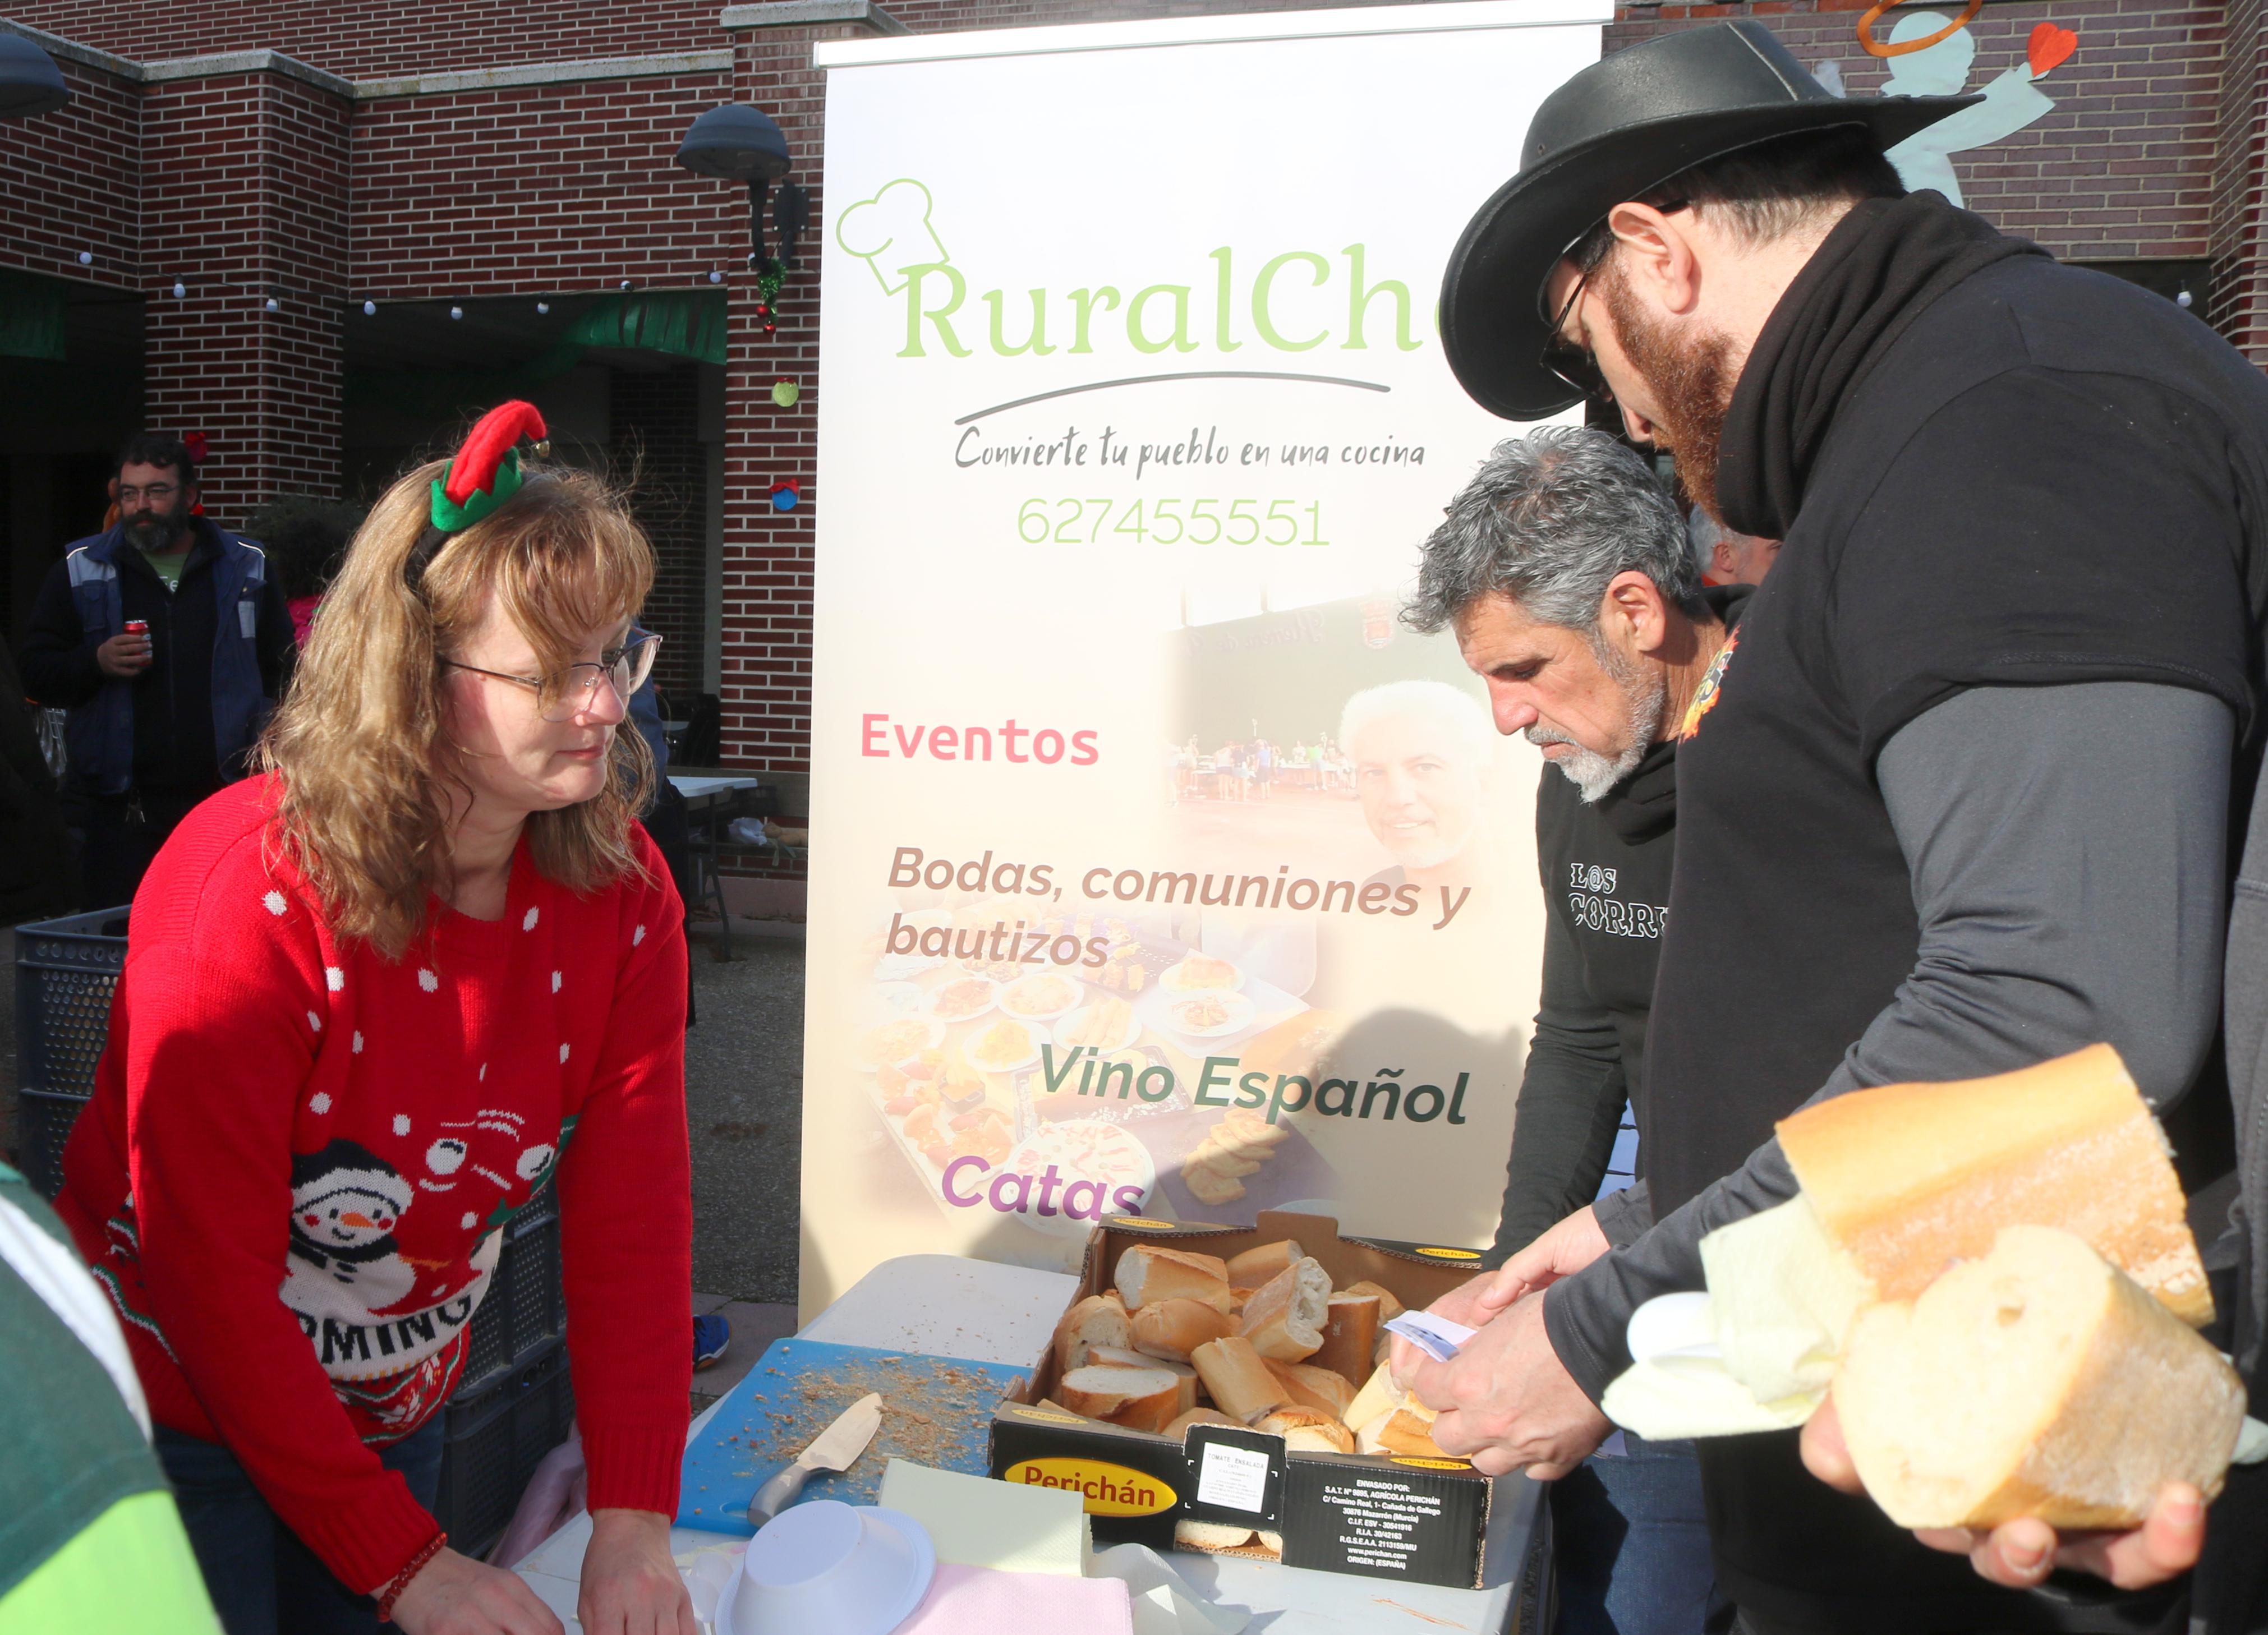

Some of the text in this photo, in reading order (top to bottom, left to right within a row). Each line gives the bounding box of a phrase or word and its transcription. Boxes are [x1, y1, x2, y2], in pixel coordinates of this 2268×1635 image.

[896, 243, 1441, 358] RuralCh
[955, 425, 1424, 480] Convierte tu pueblo en una cocina
[1017, 498, 1329, 546] 627455551
[861, 713, 1100, 766] Eventos
[887, 847, 1471, 930] Bodas, comuniones y
[885, 914, 1108, 968] bautizos
[1039, 1043, 1470, 1126] Vino Español
[941, 1155, 1145, 1221] Catas
[1025, 1466, 1155, 1507] Perichán
[1332, 1496, 1356, 1505] Camino
[1382, 1502, 1406, 1512] Cañada
[1416, 1506, 1441, 1516] Gallego
[1356, 1480, 1410, 1492] ENVASADO POR:
[1370, 1490, 1404, 1502] AGRÍCOLA
[1406, 1495, 1441, 1505] PERICHÁN
[1362, 1509, 1392, 1519] Mazarrón
[1393, 1513, 1419, 1523] (Murcia)
[1347, 1548, 1407, 1559] www.perichan.com
[1347, 1555, 1406, 1569] ORIGEN: (ESPAÑA)
